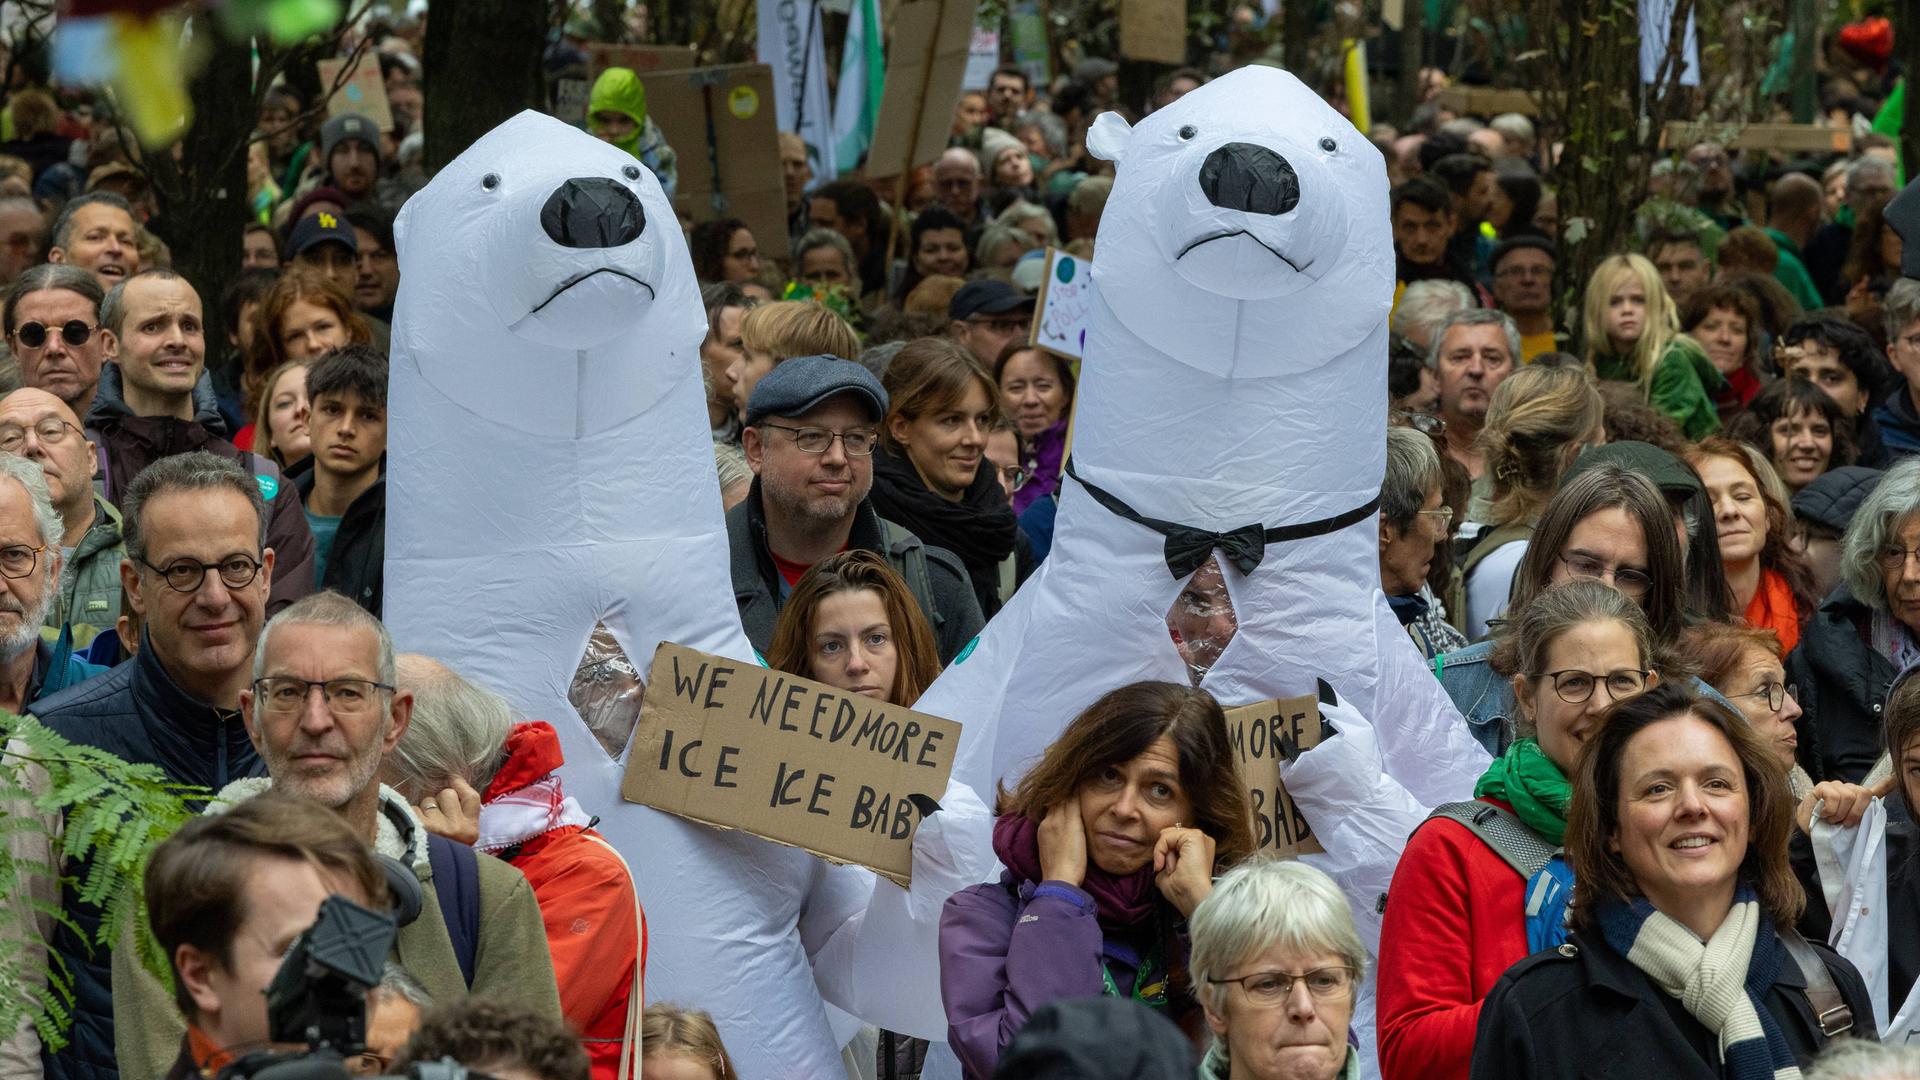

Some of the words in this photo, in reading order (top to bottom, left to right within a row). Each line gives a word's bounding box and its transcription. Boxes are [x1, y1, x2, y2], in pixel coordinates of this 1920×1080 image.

[673, 656, 734, 709] WE
[1230, 713, 1310, 763] MORE
[659, 730, 740, 788] ICE
[770, 762, 835, 816] ICE
